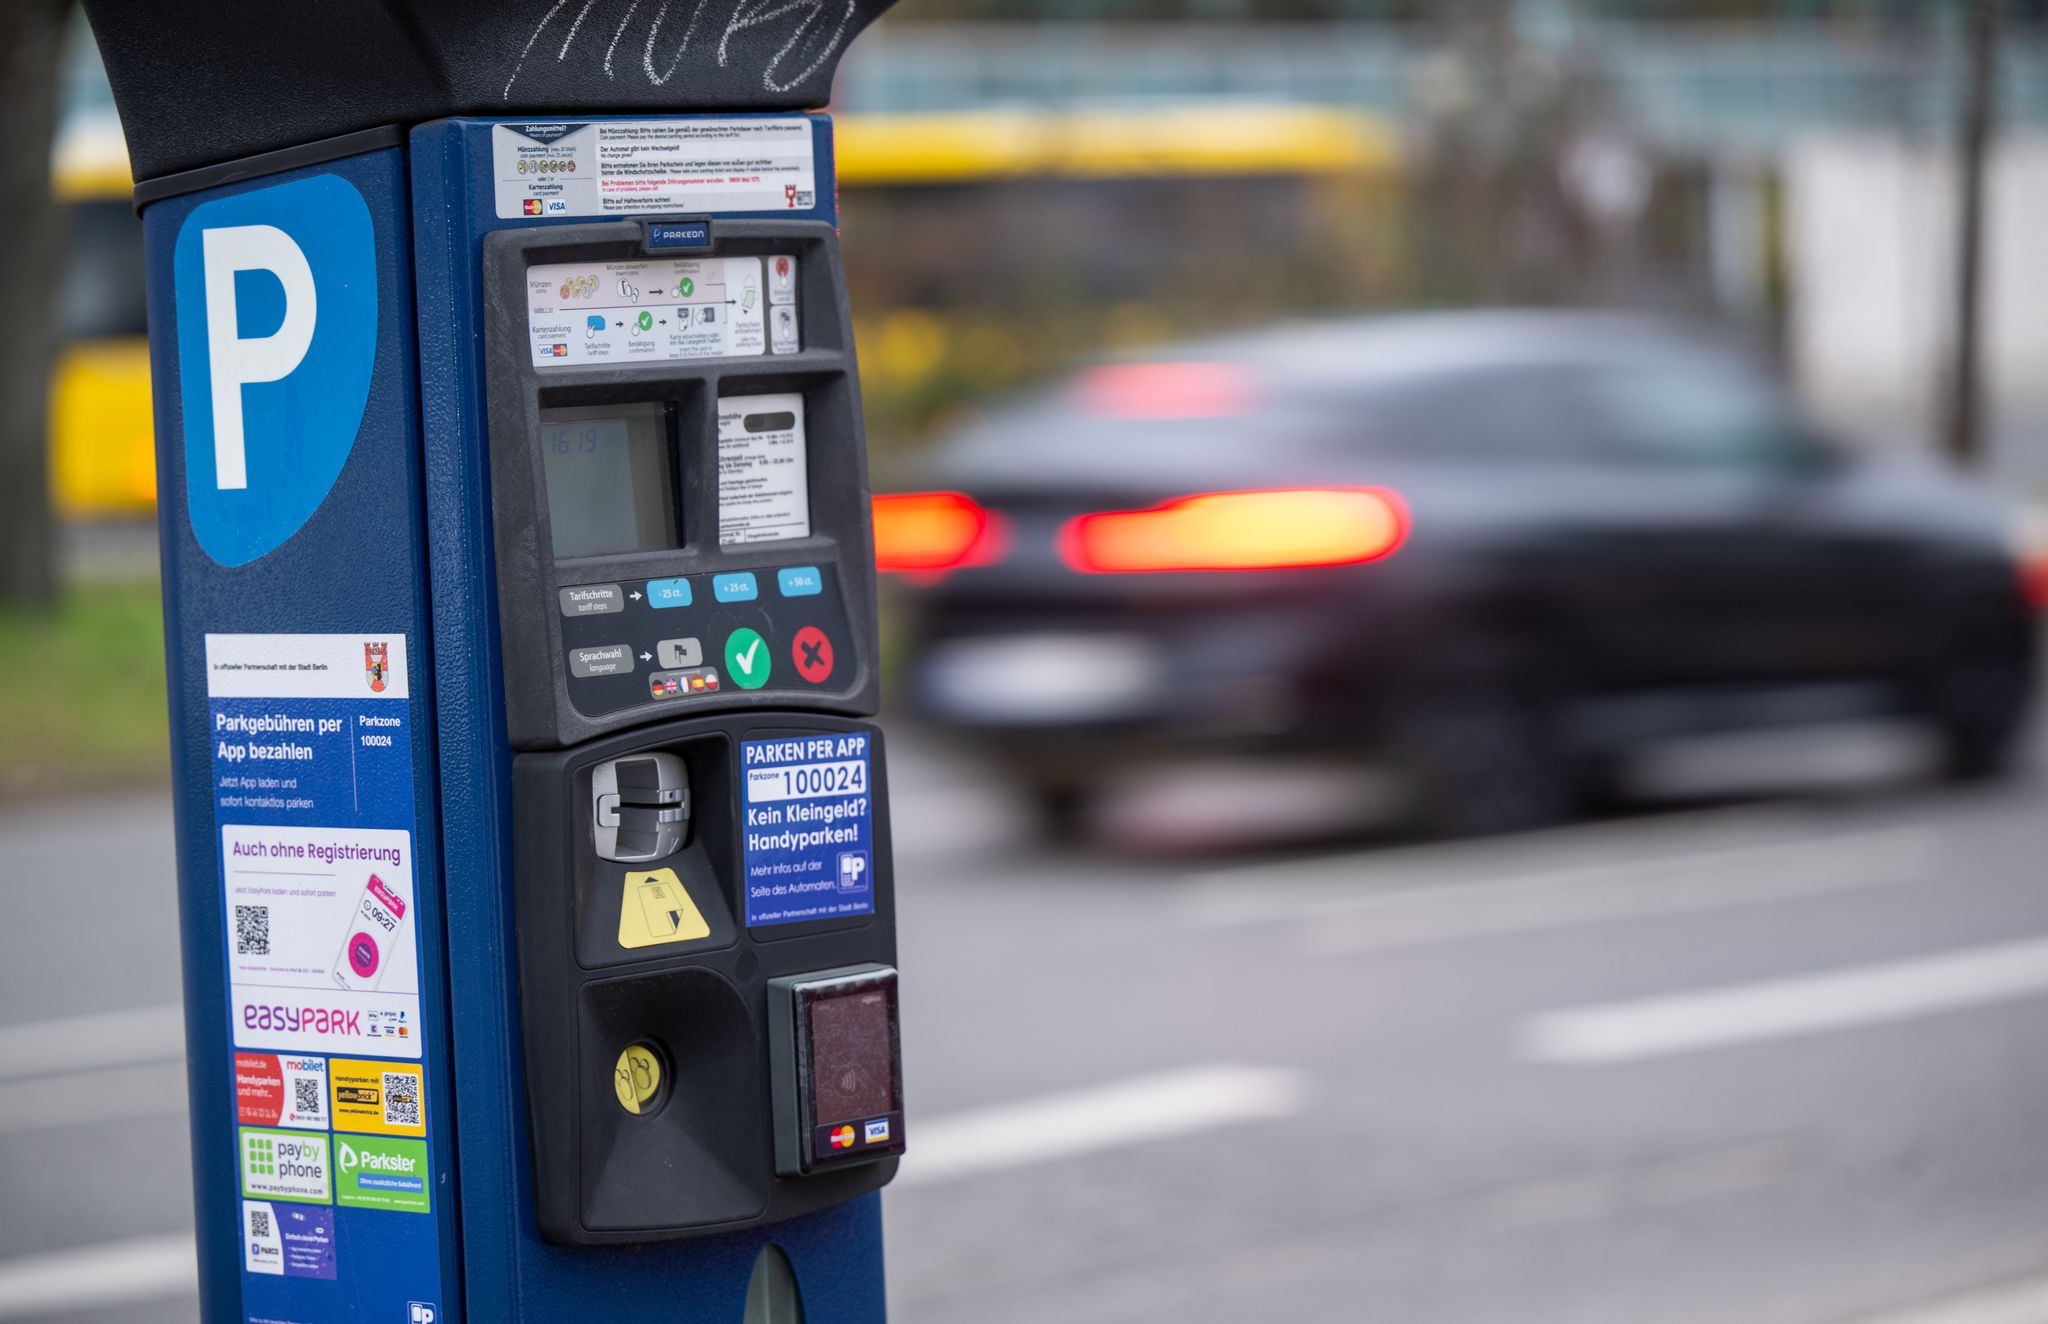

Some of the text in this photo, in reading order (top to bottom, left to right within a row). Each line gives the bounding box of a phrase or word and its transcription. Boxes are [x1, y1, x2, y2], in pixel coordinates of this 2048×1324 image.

[663, 230, 704, 239] PARKEON
[530, 280, 552, 288] Münzen
[532, 326, 571, 335] Kartenzahlung
[202, 224, 317, 490] P
[569, 589, 614, 601] Tarifschritte
[579, 649, 622, 662] Sprachwahl
[589, 662, 617, 673] language
[216, 713, 342, 735] Parkgebühren per
[359, 716, 400, 727] Parkzone
[361, 735, 392, 746] 100024
[217, 741, 313, 763] App bezahlen
[746, 737, 865, 765] PARKEN PER APP
[220, 777, 297, 789] Jetzt App laden und
[749, 765, 863, 796] Parkzone 100024
[220, 796, 314, 810] sofort kontaktlos parken
[748, 798, 867, 826] Kein Kleingeld?
[749, 823, 858, 851] Handyparken!
[233, 841, 401, 866] Auch ohne Registrierung
[750, 860, 823, 876] Mehr Infos auf der
[751, 880, 836, 898] Seite des Automaten.
[371, 907, 395, 932] 09:27
[237, 1059, 267, 1069] mobilet.de
[286, 1059, 324, 1072] mobilet
[237, 1074, 281, 1086] Handyparken
[237, 1087, 251, 1096] und
[338, 1090, 371, 1101] yellowbrick
[361, 1151, 416, 1172] Parkster
[279, 1161, 322, 1179] phone
[251, 1183, 323, 1195] www.paybyphone.com
